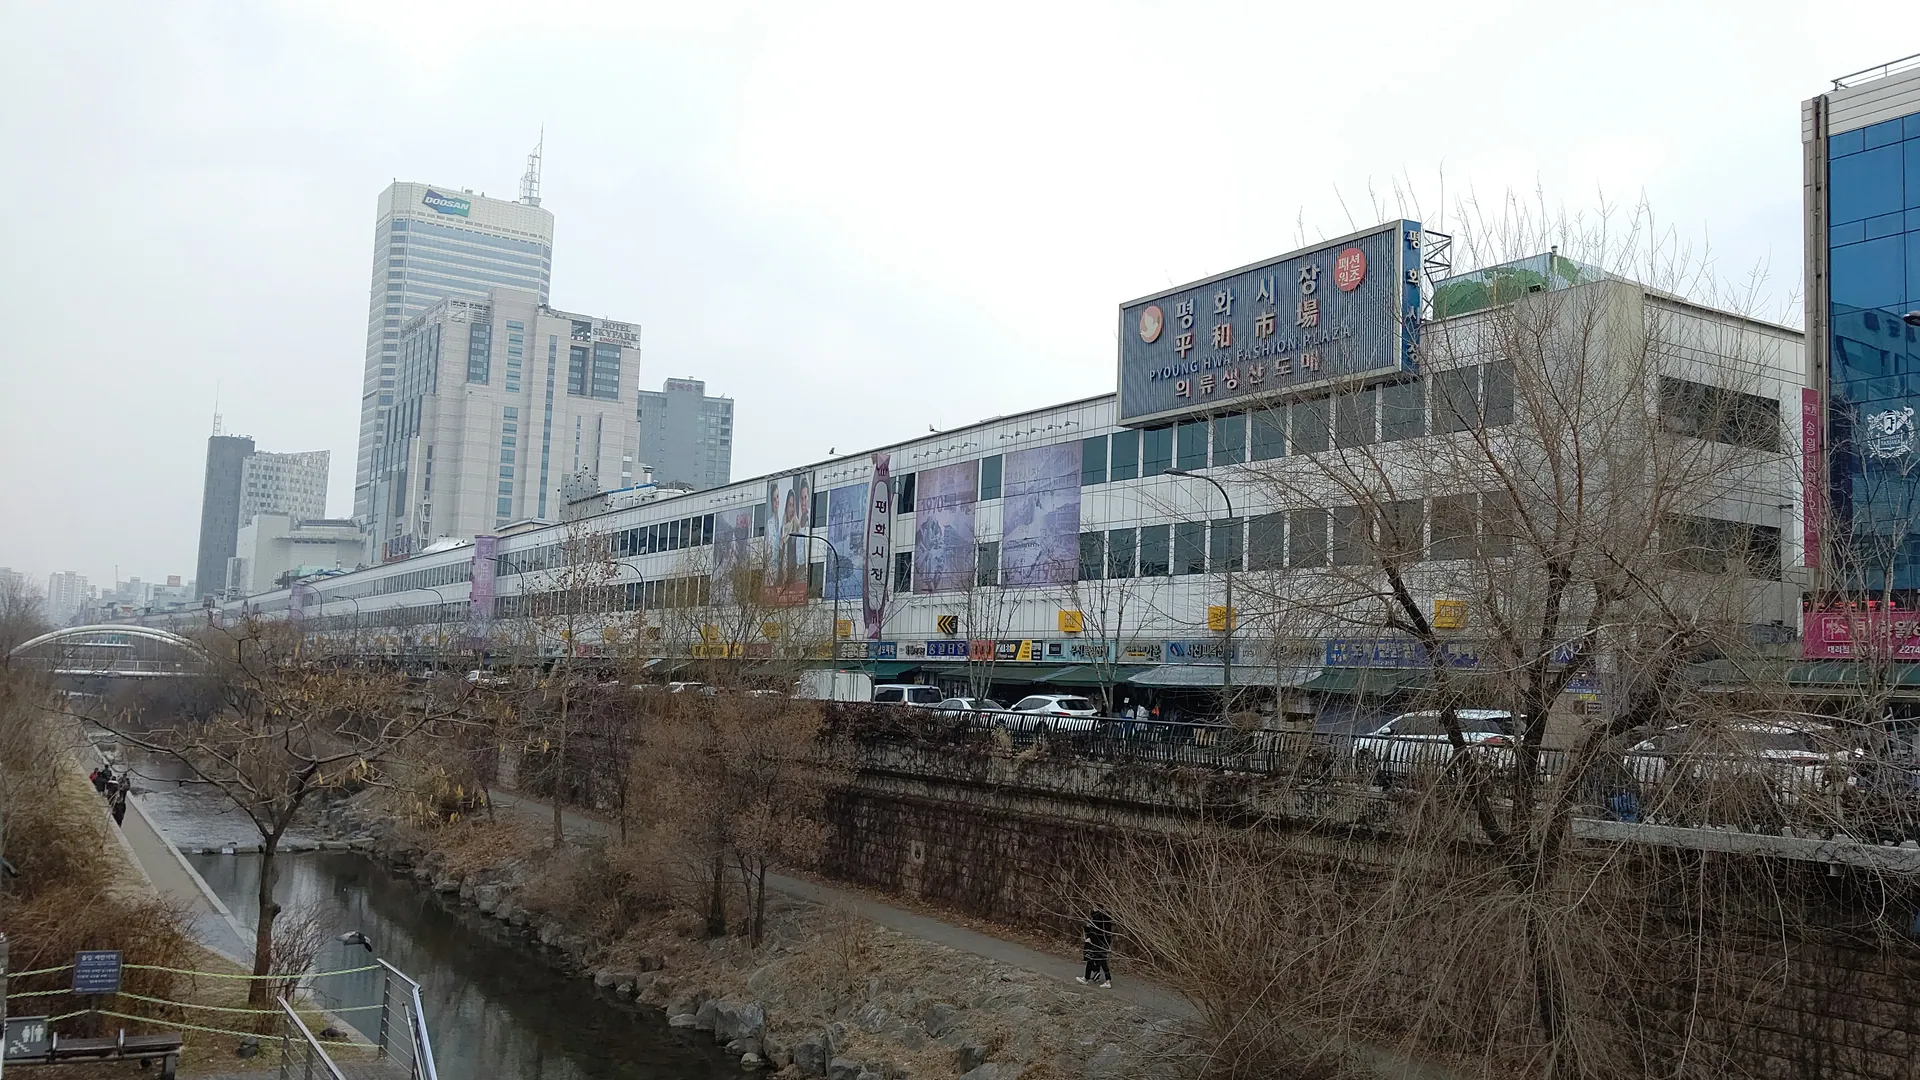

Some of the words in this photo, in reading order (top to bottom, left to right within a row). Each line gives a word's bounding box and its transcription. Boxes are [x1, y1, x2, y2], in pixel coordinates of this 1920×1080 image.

[425, 196, 469, 210] DOOSAN
[1338, 253, 1360, 271] 패션
[1338, 269, 1360, 287] 원조
[1176, 264, 1321, 330] 평화시장
[592, 328, 640, 341] SKYPARK
[602, 321, 631, 333] HOTEL
[1175, 298, 1319, 359] 平和市場
[1150, 360, 1199, 383] PYOUNG
[1204, 353, 1231, 370] HWA
[1237, 337, 1298, 362] FASHION
[1303, 324, 1352, 347] PLAZA
[871, 500, 887, 581] 평화시장
[1827, 645, 1850, 654] 대리점
